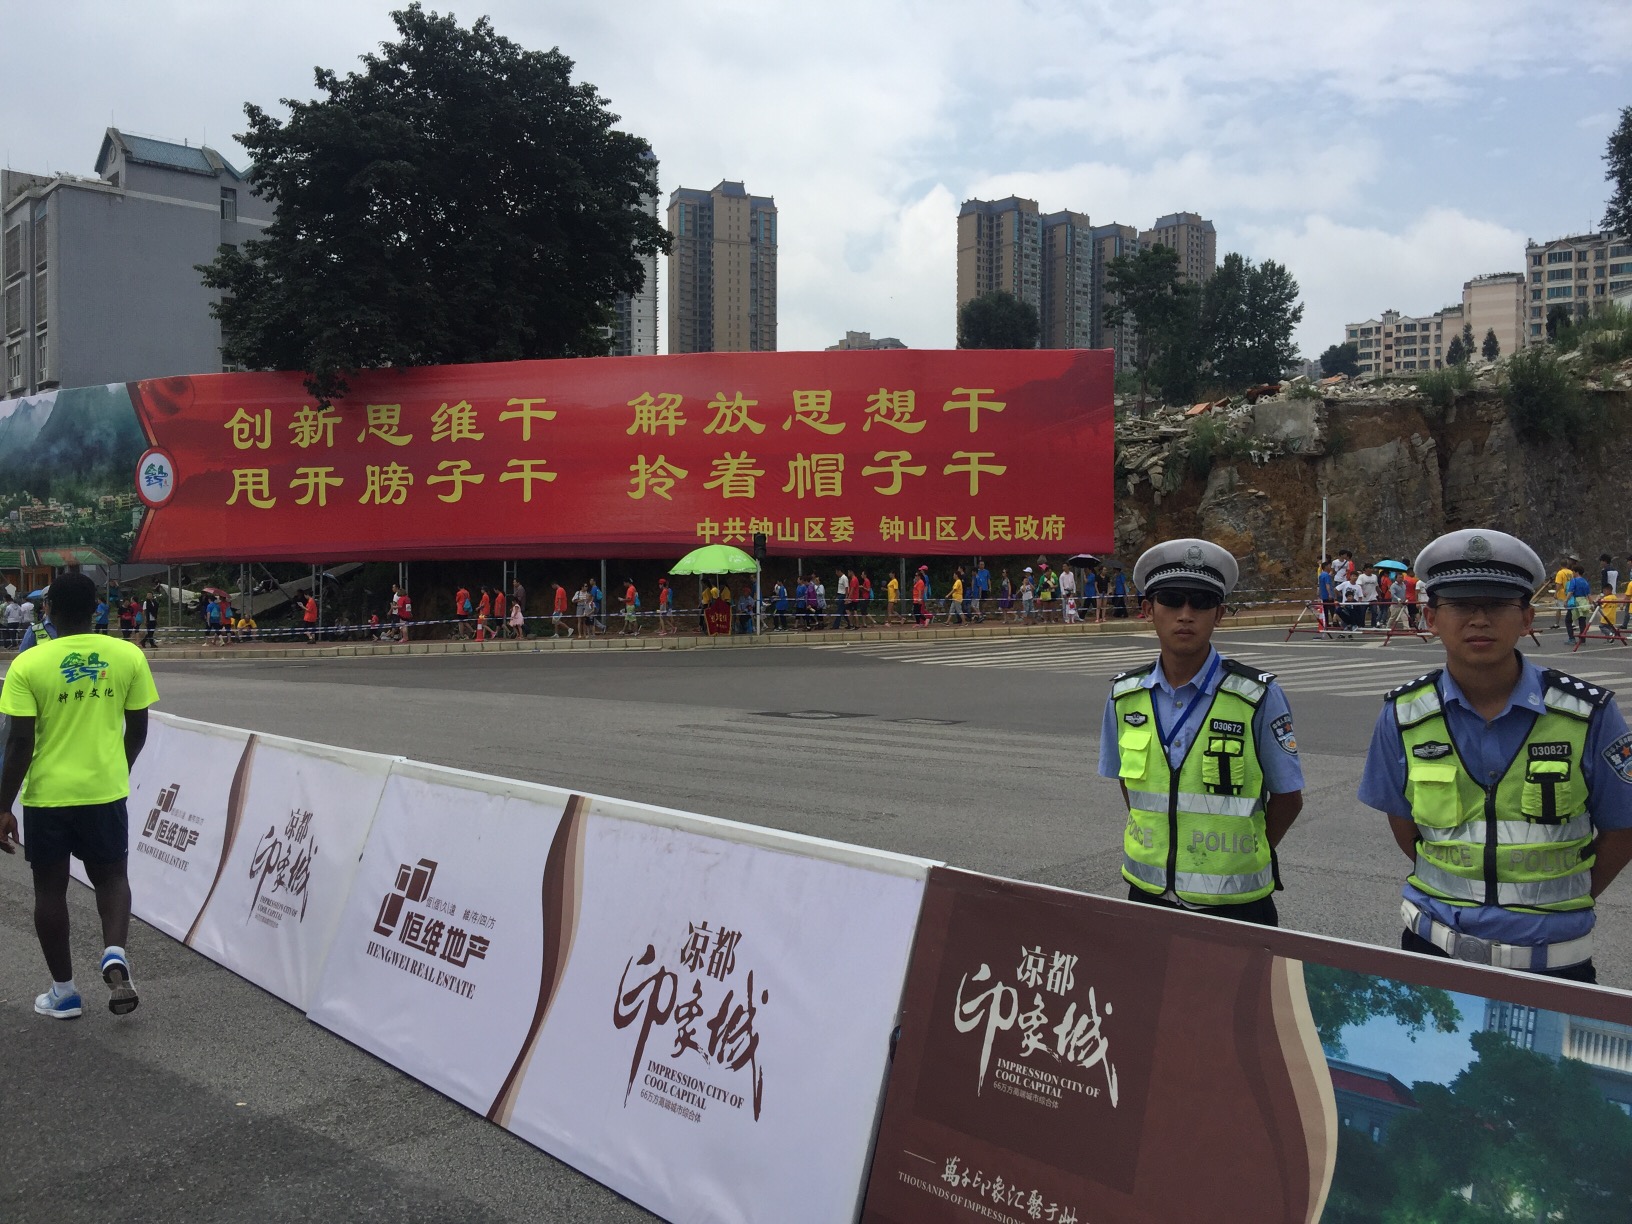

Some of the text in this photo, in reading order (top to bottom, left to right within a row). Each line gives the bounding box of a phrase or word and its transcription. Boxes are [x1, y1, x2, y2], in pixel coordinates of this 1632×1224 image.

[224, 387, 1007, 449] 创新思维干 解放思想干
[225, 450, 1007, 509] 甩开膀子干 拎着帽子干
[696, 515, 1066, 544] 中共钟山区委 钟山区人民政府
[1213, 721, 1242, 734] 030672
[1531, 744, 1569, 756] 030827
[399, 911, 490, 968] 恒维地产
[680, 920, 743, 982] 凉都
[366, 941, 477, 1000] HENGWEI REAL ESTATE
[1016, 945, 1079, 996] 凉都
[644, 1074, 707, 1110] COOL CAPITAL
[647, 1060, 745, 1109] IMPRESSION CITY OF
[995, 1069, 1063, 1099] COOL CAPITAL
[997, 1058, 1101, 1098] IMPRESSION CITY OF
[898, 1171, 1026, 1224] THOUSANDS OF IMPRESSIO
